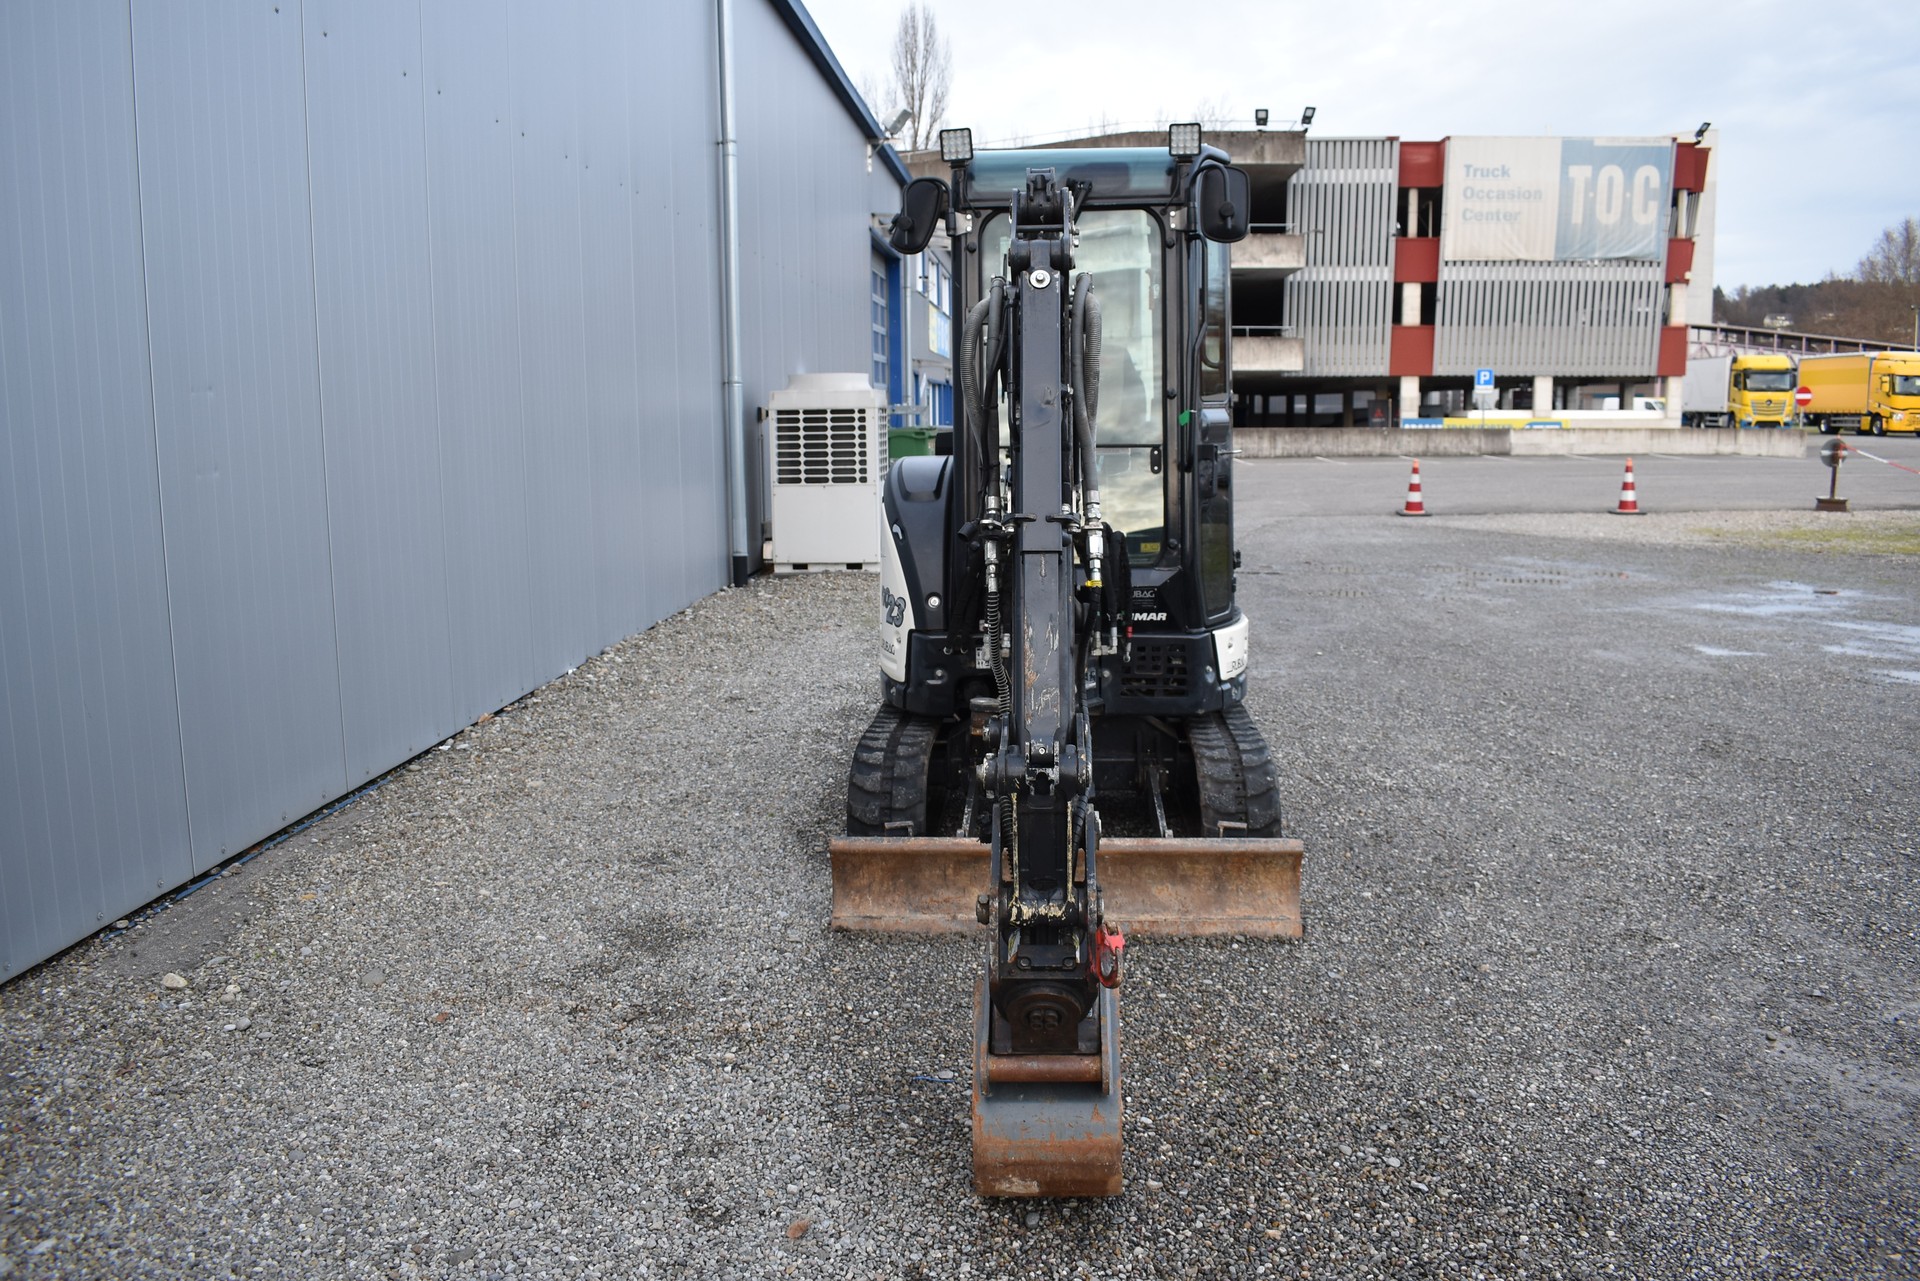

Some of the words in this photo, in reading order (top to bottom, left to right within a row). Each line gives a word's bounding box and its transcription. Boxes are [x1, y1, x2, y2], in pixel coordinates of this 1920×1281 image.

[1463, 164, 1511, 178] Truck
[1462, 186, 1543, 200] Occasion
[1461, 207, 1522, 222] Center
[1480, 371, 1490, 385] P
